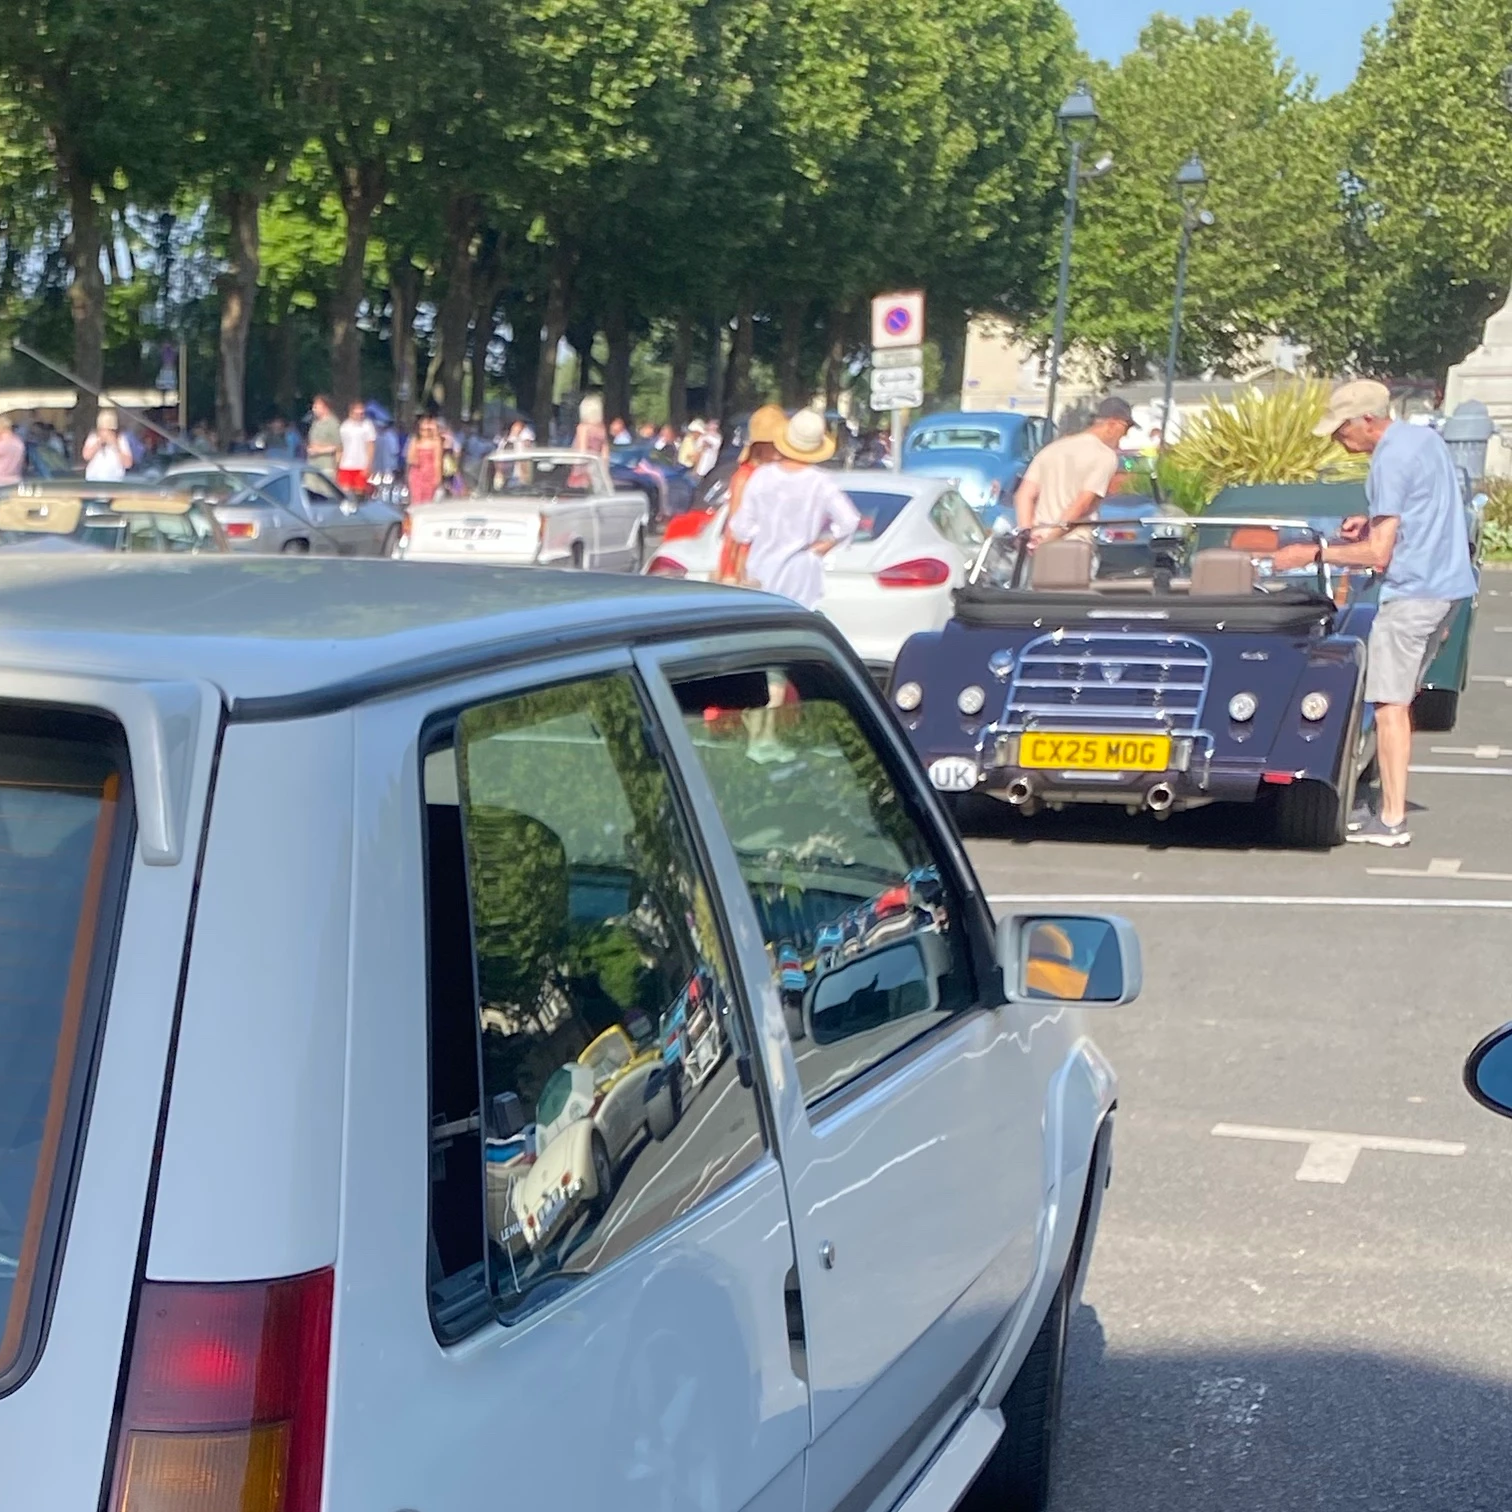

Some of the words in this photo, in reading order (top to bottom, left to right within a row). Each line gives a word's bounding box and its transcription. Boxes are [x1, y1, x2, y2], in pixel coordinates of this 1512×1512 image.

[1031, 739, 1098, 763] CX25
[1104, 741, 1156, 765] MOG
[936, 766, 971, 787] UK
